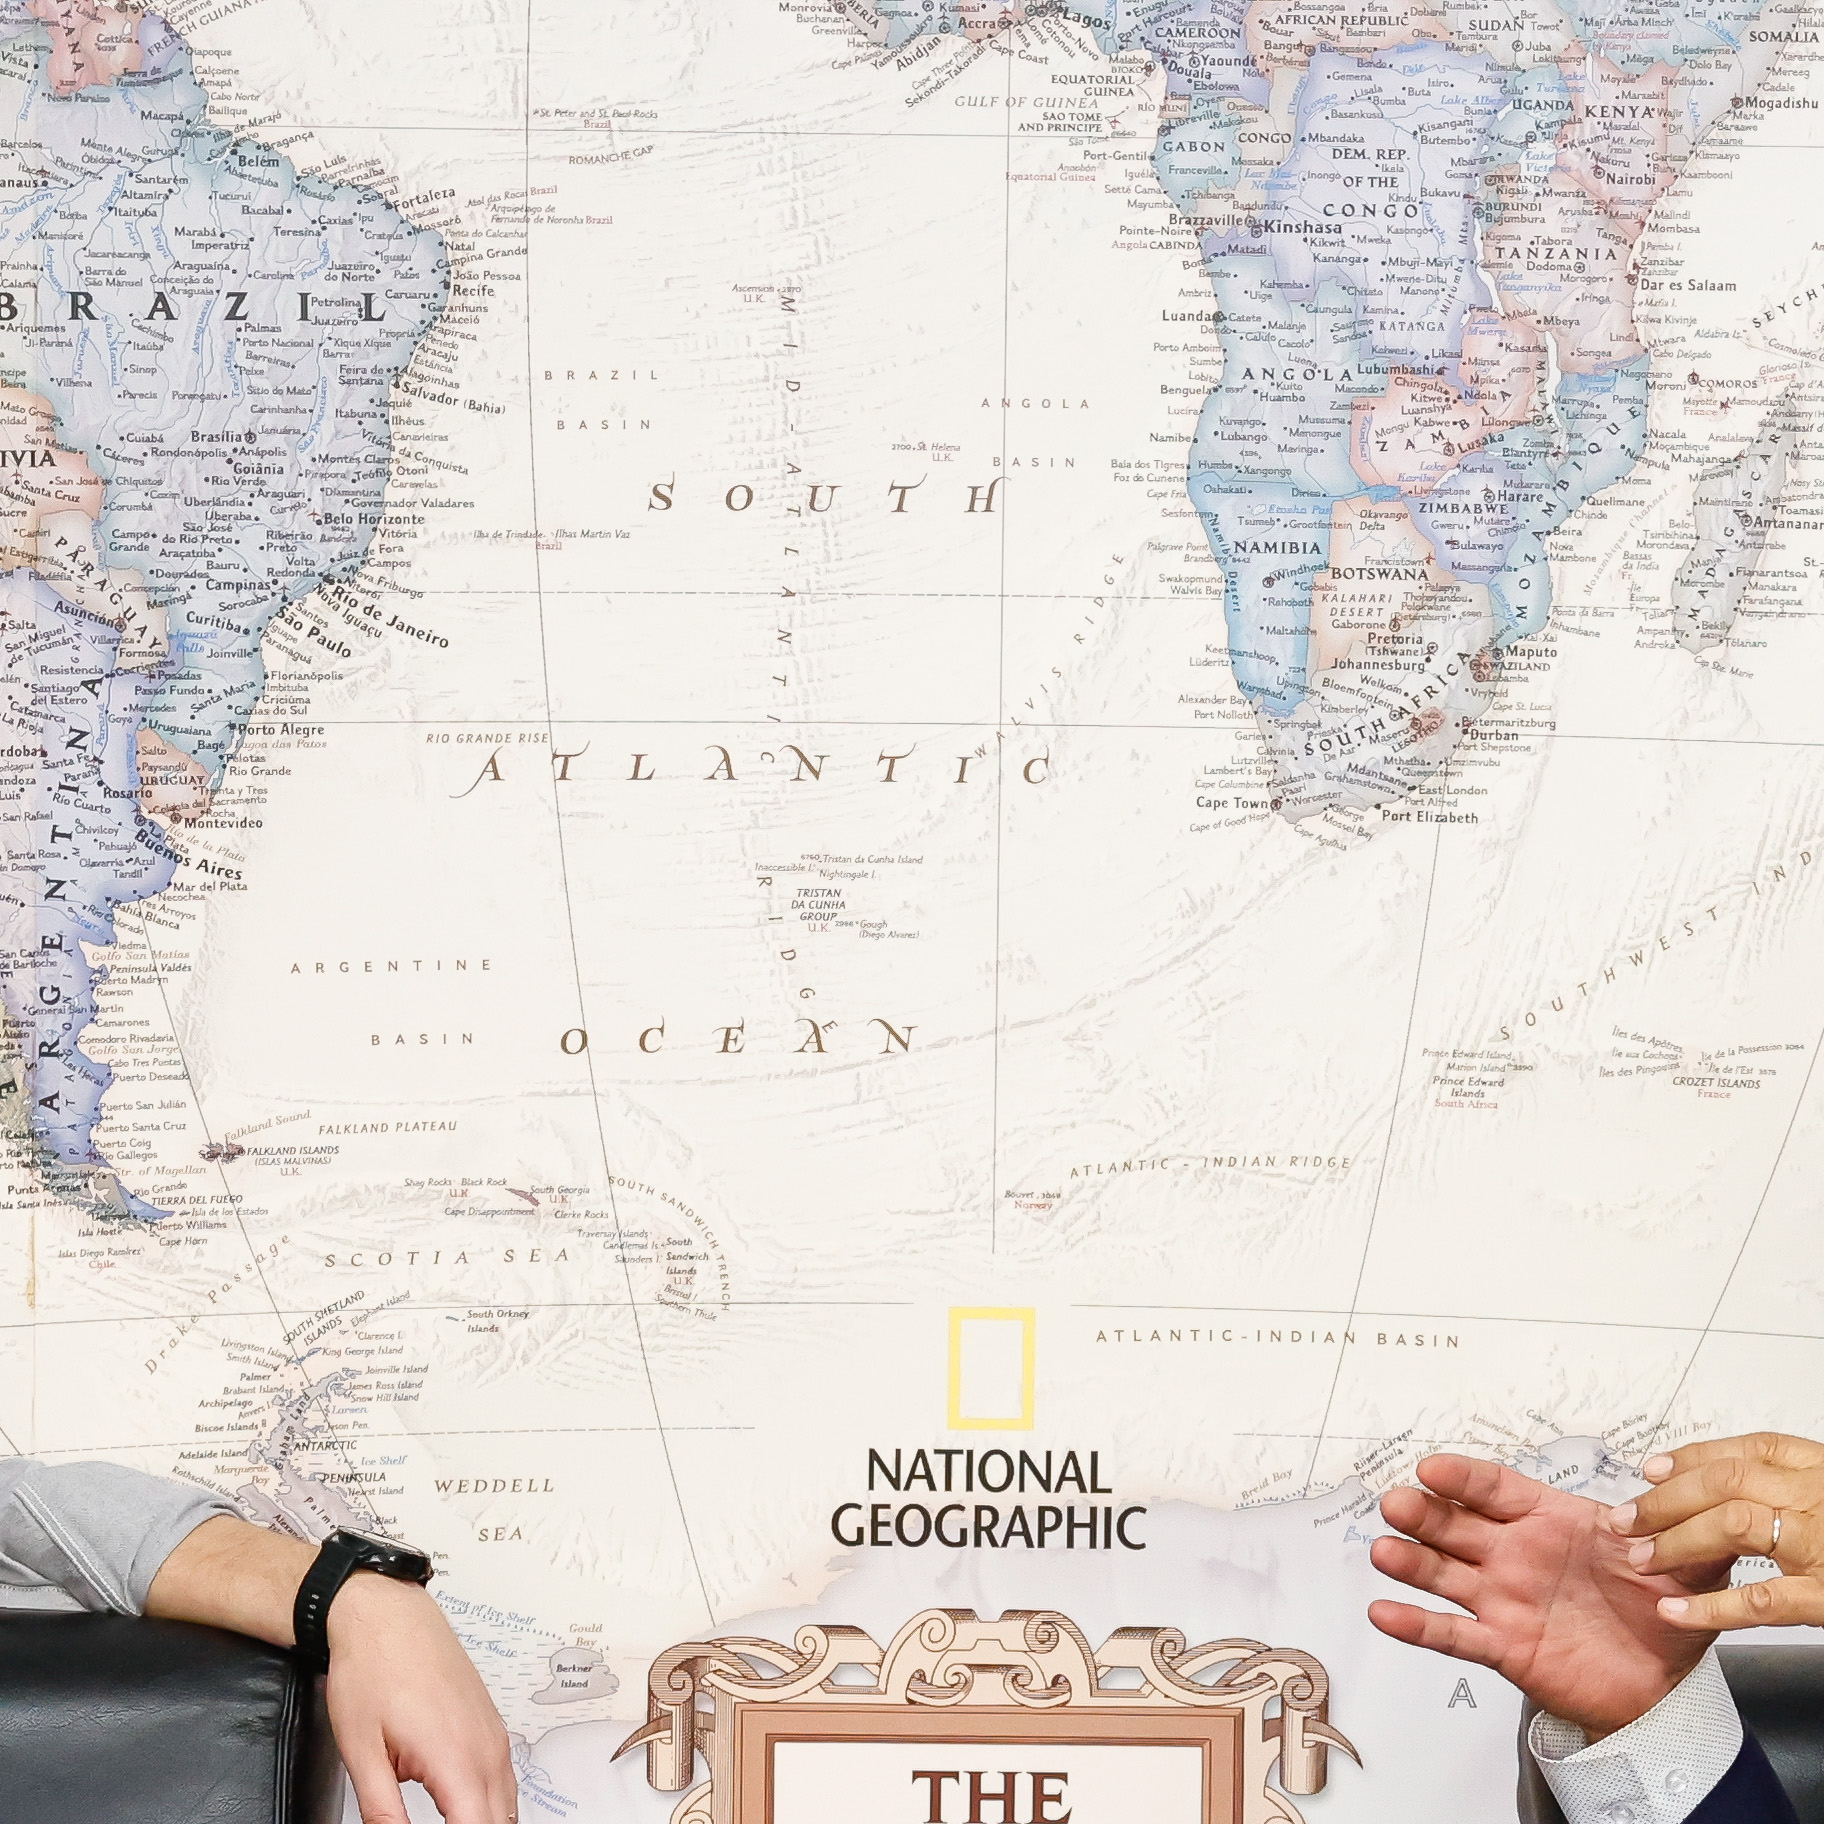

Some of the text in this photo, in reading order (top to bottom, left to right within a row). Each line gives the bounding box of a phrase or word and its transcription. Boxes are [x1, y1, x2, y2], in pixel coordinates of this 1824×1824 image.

[1155, 27, 1241, 39] CAMEROON
[1511, 98, 1575, 112] UGANDA
[1585, 105, 1654, 118] KENYA
[1163, 141, 1225, 152] GABON
[237, 154, 279, 167] Belém
[1333, 148, 1410, 160] DEM. REP.
[1343, 177, 1399, 188] OF THE
[1607, 173, 1655, 185] Nairobi
[393, 188, 456, 210] Fortaleza
[1323, 204, 1417, 218] CONGO
[1263, 220, 1342, 234] Kinshasa
[1495, 247, 1617, 260] TANZANIA
[453, 284, 494, 296] Recife
[1641, 278, 1736, 291] Dar es Salaam
[1163, 310, 1212, 324] Luanda
[545, 371, 657, 380] BRAZIL
[1241, 368, 1353, 381] ANGOLA
[558, 420, 650, 429] BASIN
[191, 430, 242, 442] Brasília
[649, 472, 1009, 513] SOUTH
[1419, 503, 1509, 515] ZIMBABWE
[324, 512, 424, 527] Belo Horizonte
[1233, 540, 1322, 554] NAMIBIA
[1330, 566, 1429, 581] BOTSWANA
[1366, 633, 1422, 647] Pretoria
[1330, 658, 1426, 674] Johannesburg
[238, 722, 325, 738] Porto Alegre
[1469, 728, 1518, 740] Durban
[426, 733, 548, 743] RIO GRANDE RISE
[450, 743, 1052, 799] ATLANTIC
[1197, 796, 1273, 811] Cape Town
[184, 817, 262, 828] Montevideo
[1383, 810, 1478, 823] Port Elizabeth
[291, 960, 491, 974] ARGENTINE
[372, 1034, 473, 1045] BASIN
[560, 1017, 917, 1055] OCEAN
[319, 1121, 457, 1135] FALKLAND PLATEAU
[325, 1248, 568, 1268] SCOTIA SEA
[1097, 1328, 1458, 1348] ATLANTIC-INDIAN BASIN
[869, 1448, 1112, 1493] NATIONAL
[435, 1479, 554, 1494] WEDDELL
[832, 1504, 1147, 1550] GEOGRAPHIC
[478, 1527, 523, 1542] SEA
[912, 1770, 1072, 1824] THE
